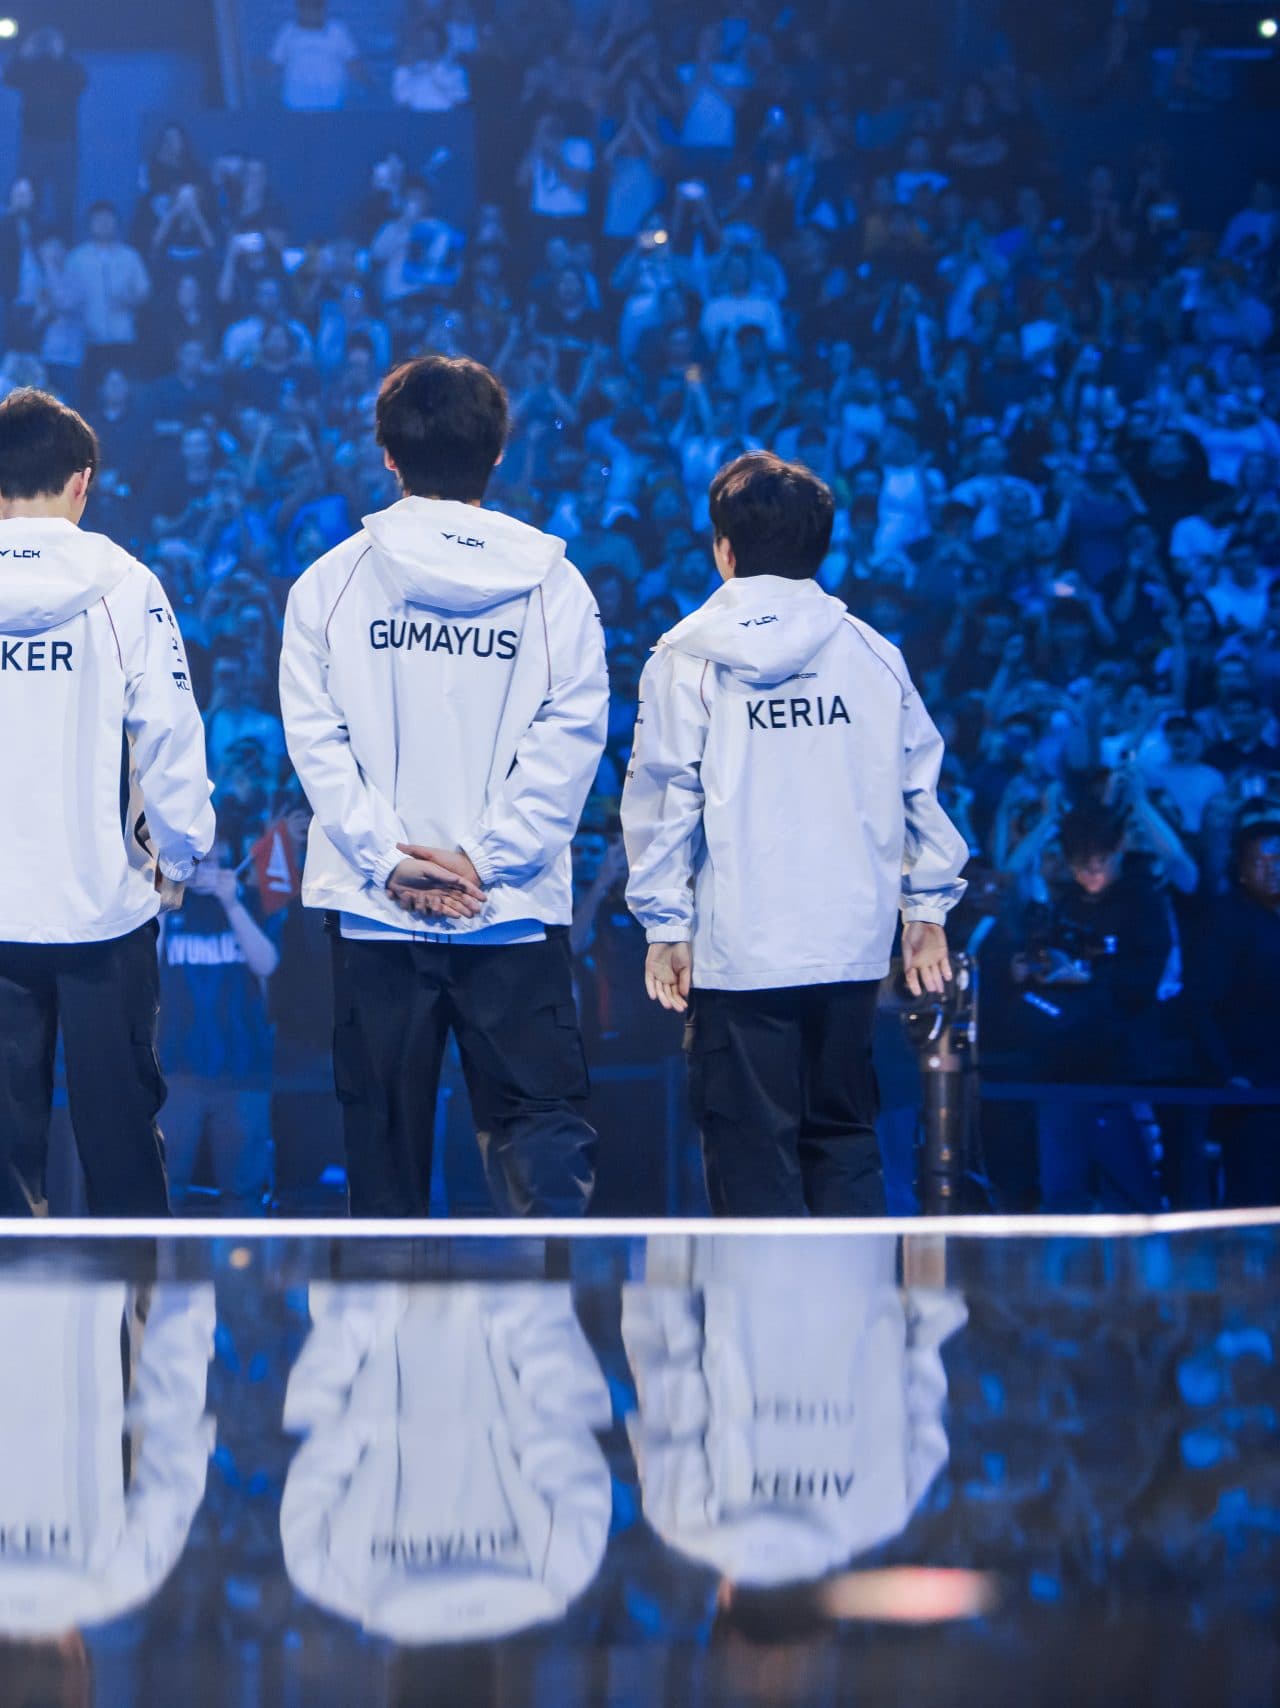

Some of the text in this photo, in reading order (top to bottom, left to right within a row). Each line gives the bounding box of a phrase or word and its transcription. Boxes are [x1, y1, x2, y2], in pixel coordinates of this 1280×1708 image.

[13, 549, 41, 559] LCK
[457, 536, 486, 549] LCK
[369, 618, 519, 660] GUMAYUS
[746, 695, 852, 730] KERIA
